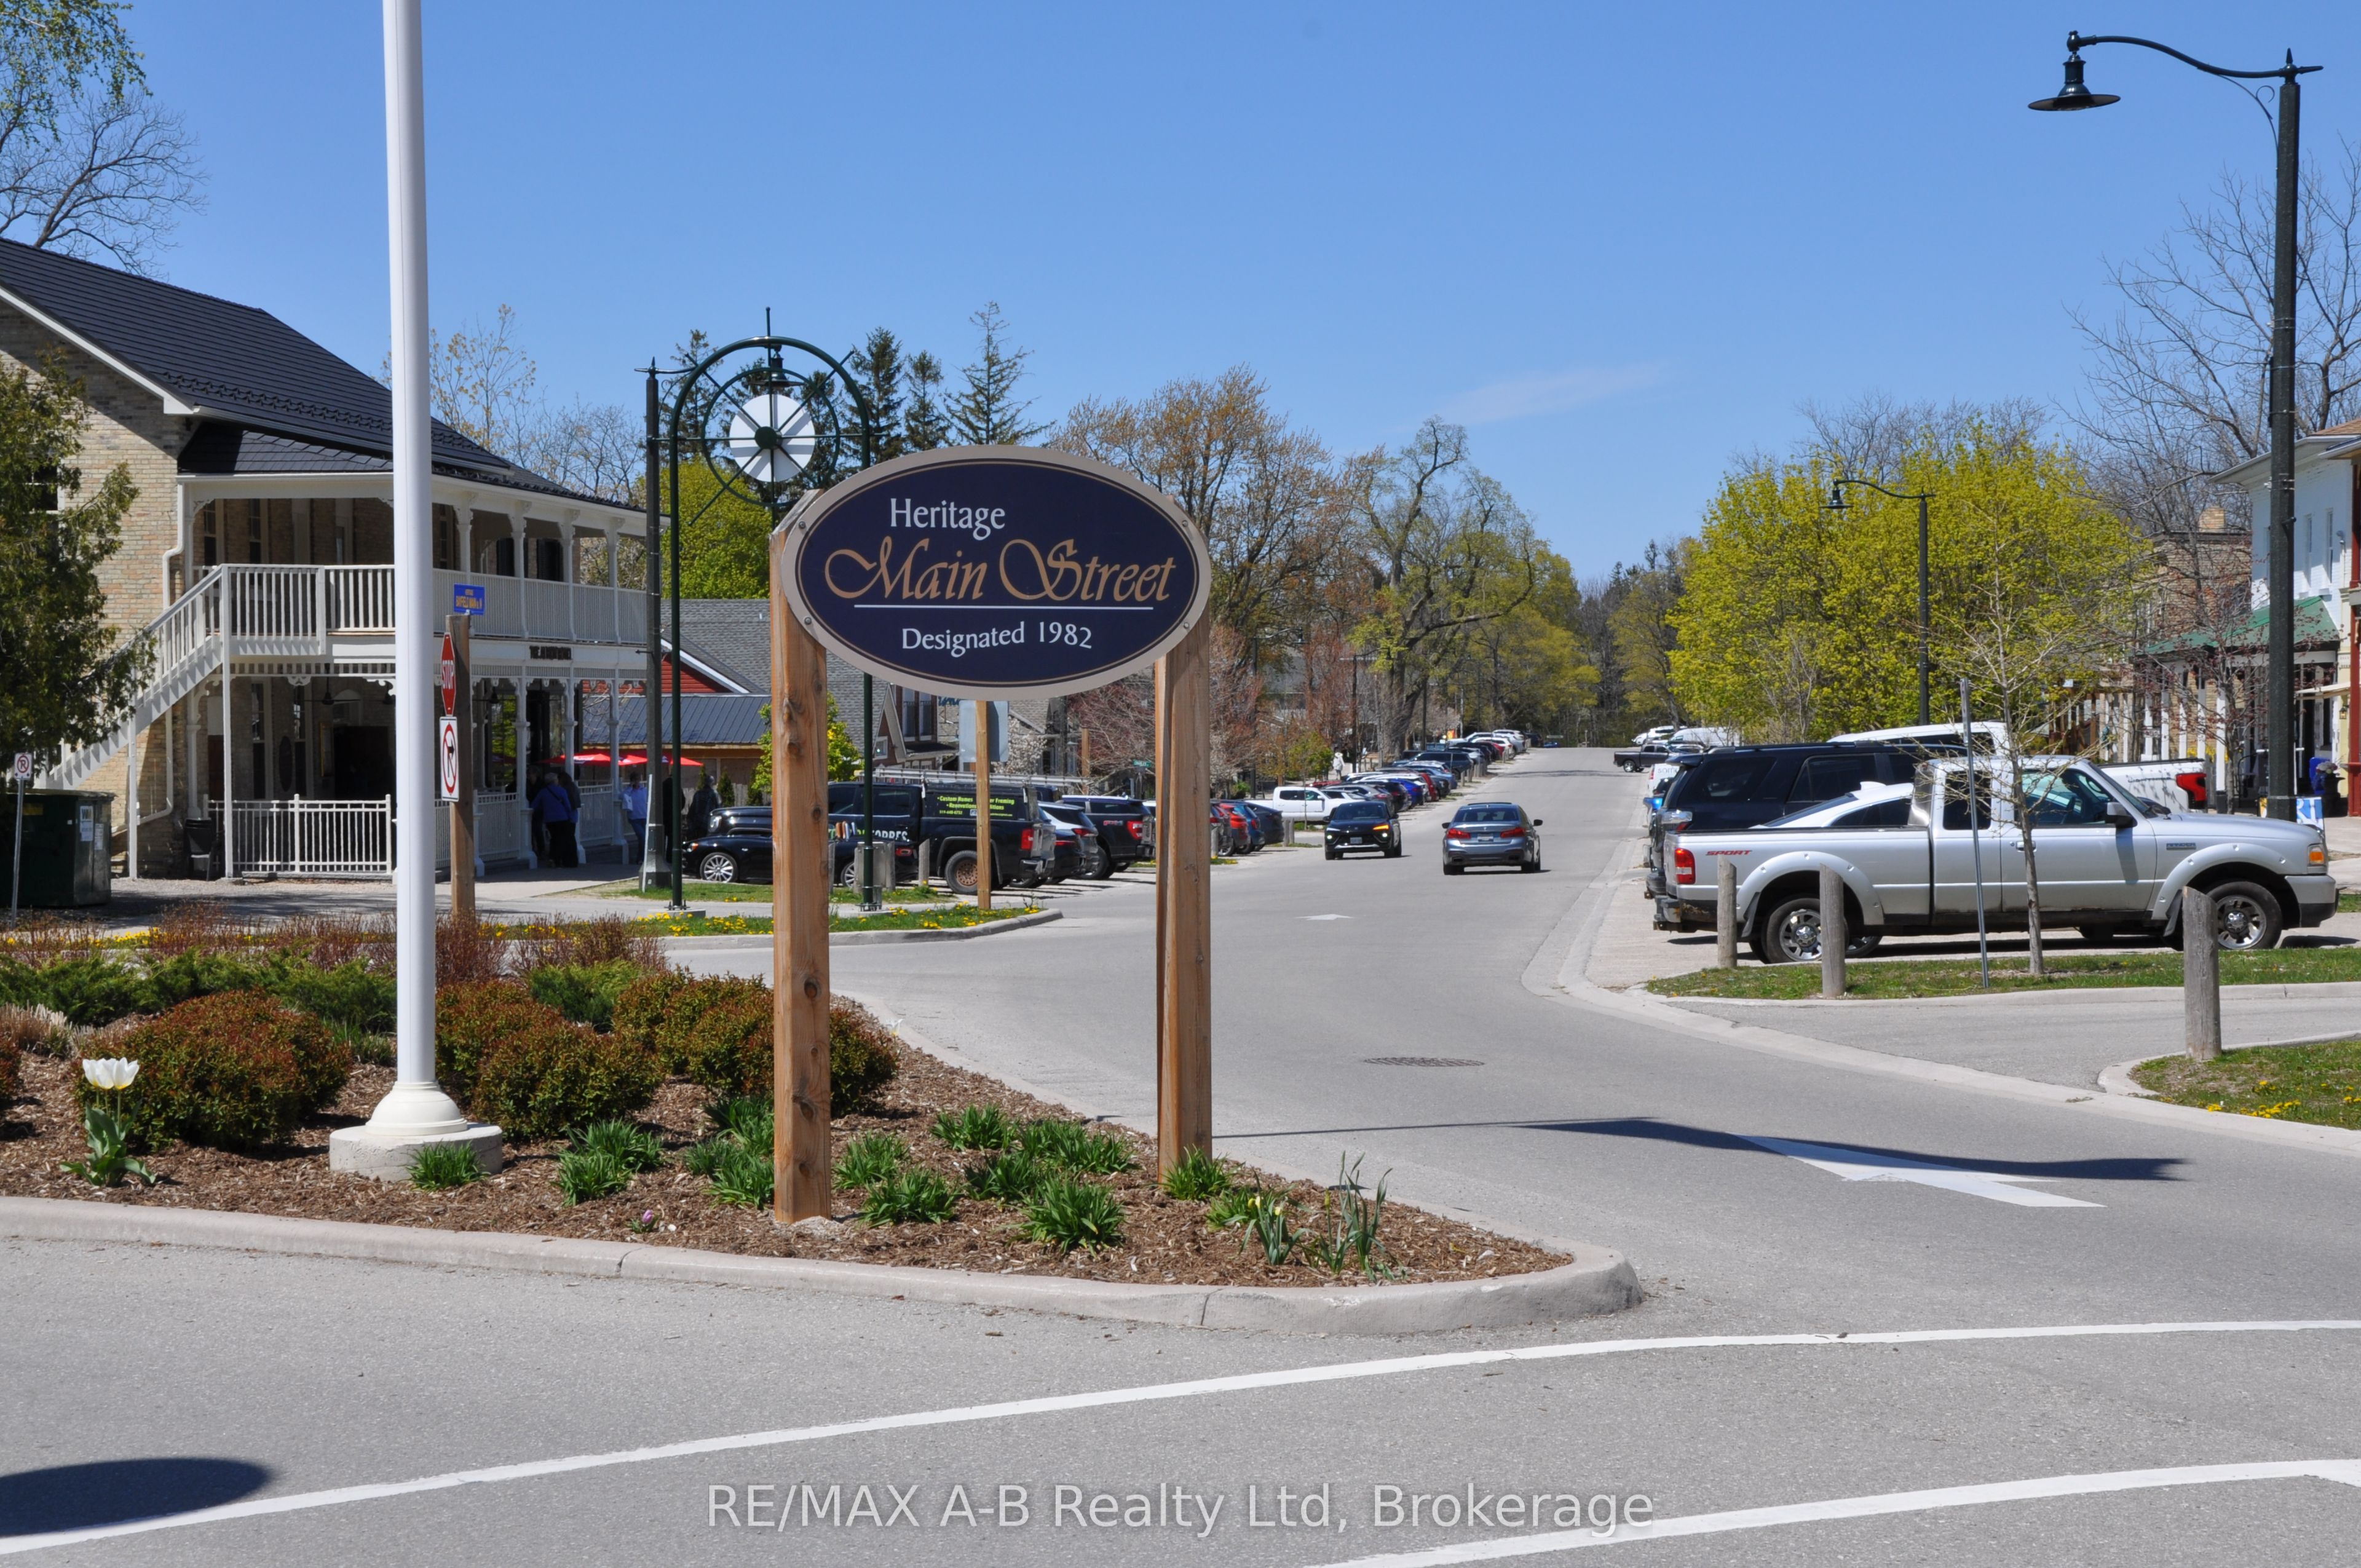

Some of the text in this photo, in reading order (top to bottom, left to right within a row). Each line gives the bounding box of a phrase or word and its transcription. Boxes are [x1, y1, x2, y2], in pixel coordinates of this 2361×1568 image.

[890, 498, 1005, 540] Heritage
[825, 536, 1176, 602] Main Street
[903, 622, 1092, 657] Designated 1982
[442, 660, 454, 689] STOP
